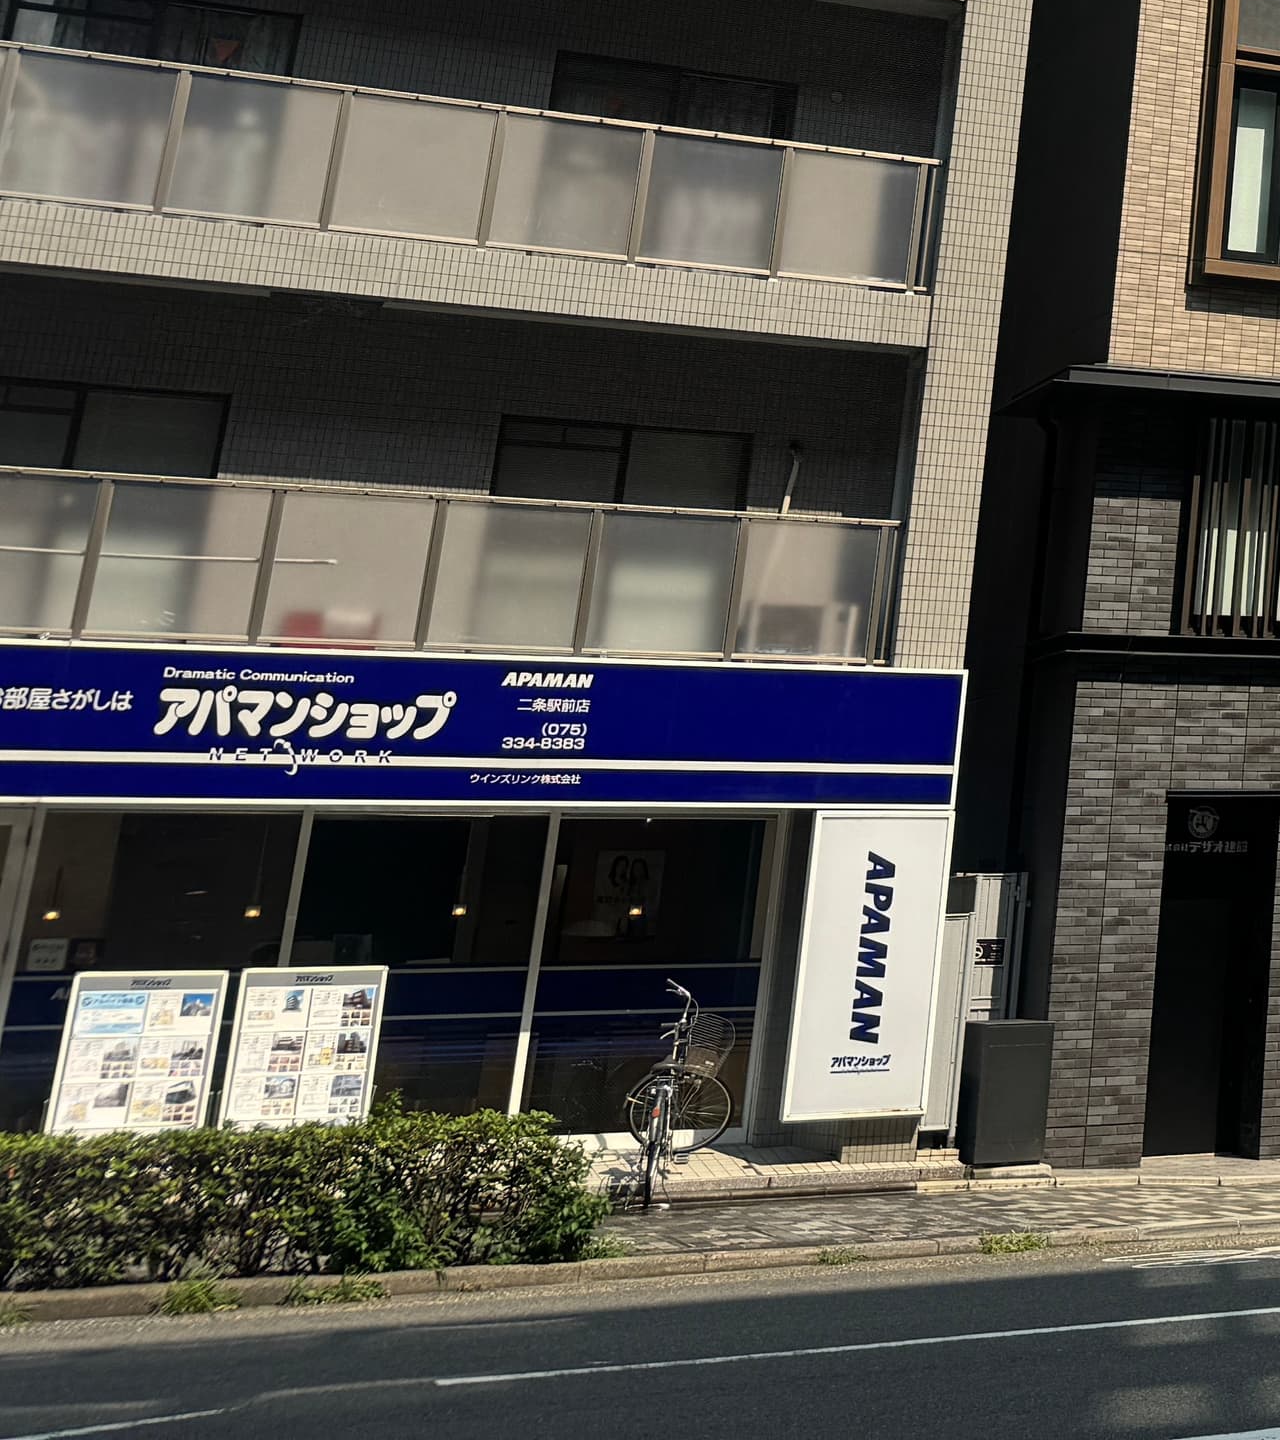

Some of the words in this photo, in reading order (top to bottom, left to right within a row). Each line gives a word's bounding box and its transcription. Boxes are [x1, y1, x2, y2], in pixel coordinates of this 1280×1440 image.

[163, 666, 236, 680] Dramatic
[239, 668, 355, 684] Communication
[501, 672, 594, 688] APAMAN
[0, 686, 134, 711] 部屋さがしは
[517, 698, 591, 713] 二条駅前店
[153, 685, 457, 740] アパマンショップ
[541, 722, 588, 737] (075)
[501, 737, 585, 750] 334-8383
[849, 850, 897, 1045] APAMAN
[830, 1053, 892, 1068] アパマンショップ
